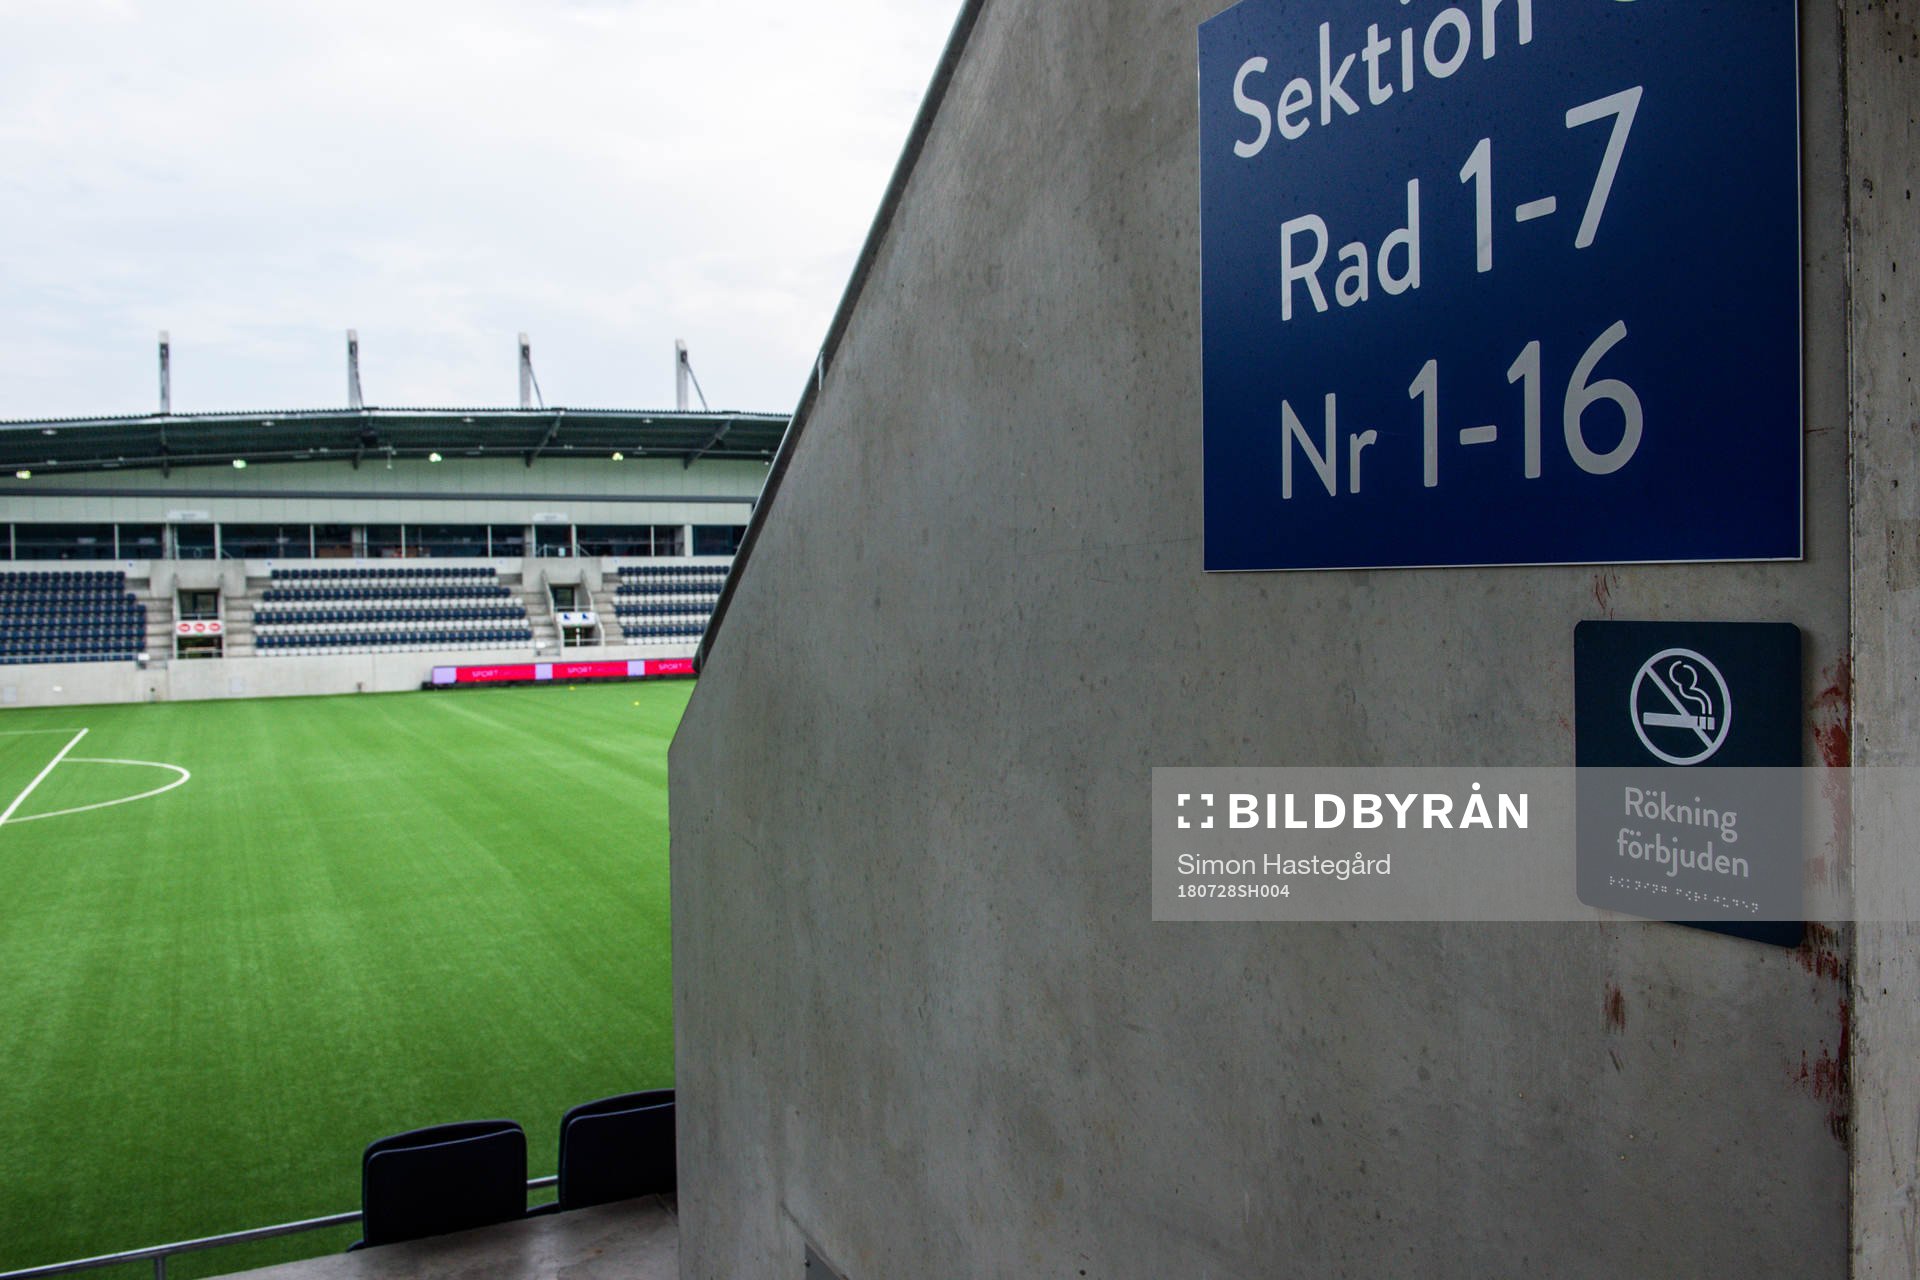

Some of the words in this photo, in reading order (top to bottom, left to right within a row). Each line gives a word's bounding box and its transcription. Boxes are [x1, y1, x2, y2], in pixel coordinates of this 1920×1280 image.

[1233, 0, 1533, 158] Sektion
[1281, 178, 1420, 321] Rad
[1459, 85, 1643, 273] 1-7
[1282, 393, 1377, 499] Nr
[1408, 320, 1643, 487] 1-16
[1617, 828, 1749, 877] förbjuden
[1625, 786, 1738, 843] Rökning
